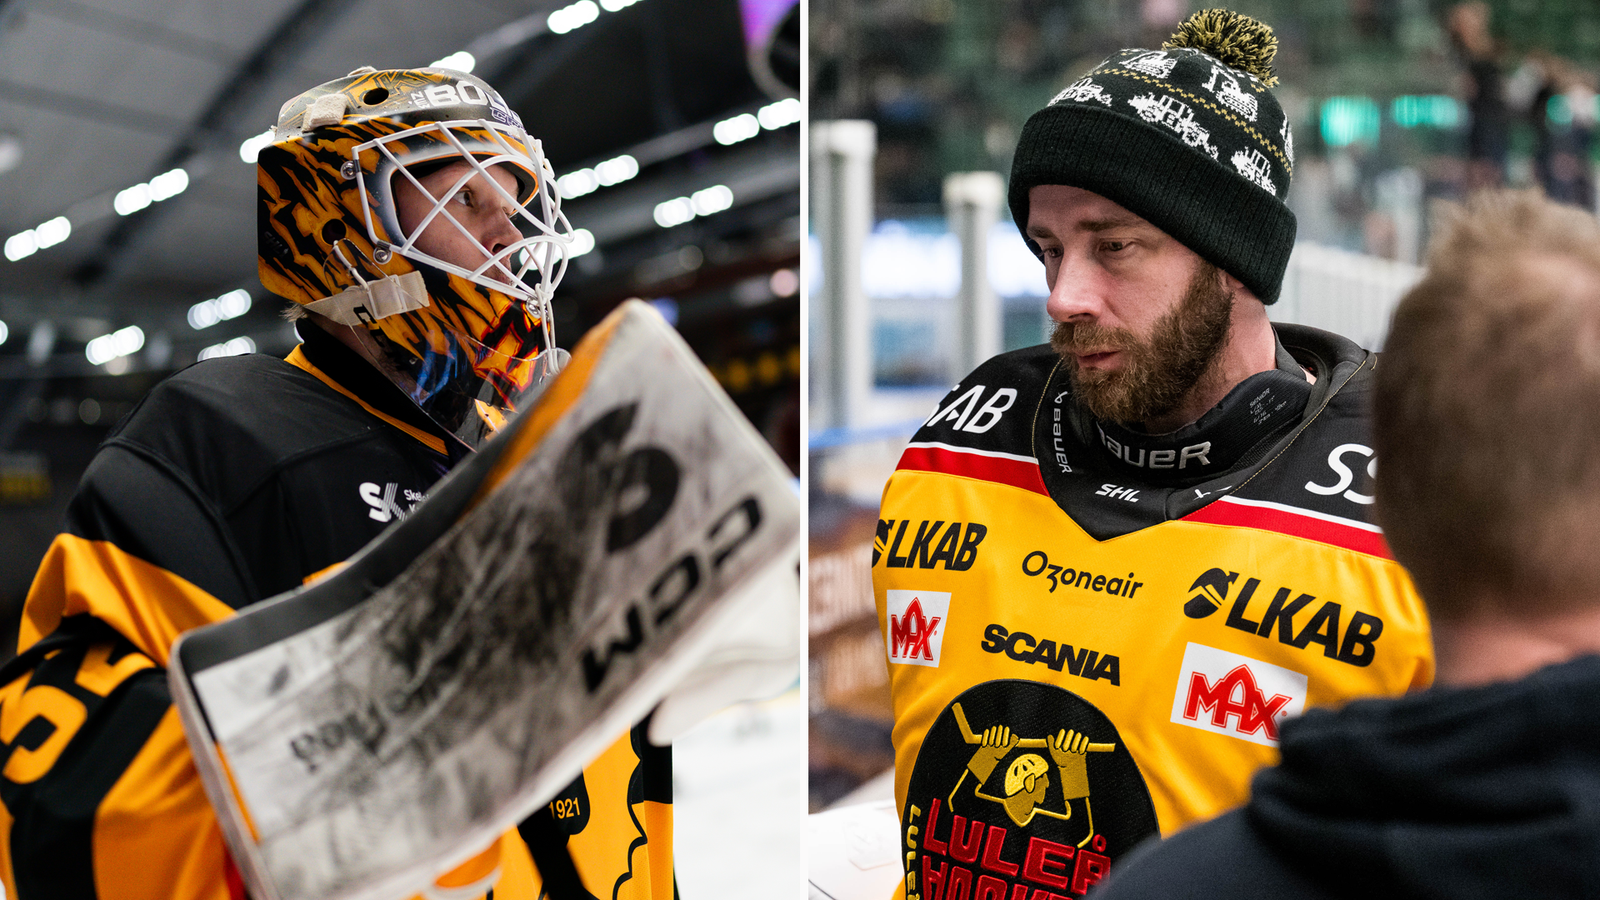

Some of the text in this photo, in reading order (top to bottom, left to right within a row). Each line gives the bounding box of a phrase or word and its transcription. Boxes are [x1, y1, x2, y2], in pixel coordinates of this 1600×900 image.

[921, 384, 1018, 434] AB
[1095, 483, 1141, 503] SHL
[886, 519, 988, 572] LKAB
[1021, 550, 1144, 599] Ozoneair
[580, 493, 766, 694] CCM
[1224, 577, 1384, 668] LKAB
[890, 596, 942, 662] MAX
[980, 623, 1121, 687] SCANIA
[1182, 663, 1294, 742] MAX
[548, 797, 581, 820] 1921
